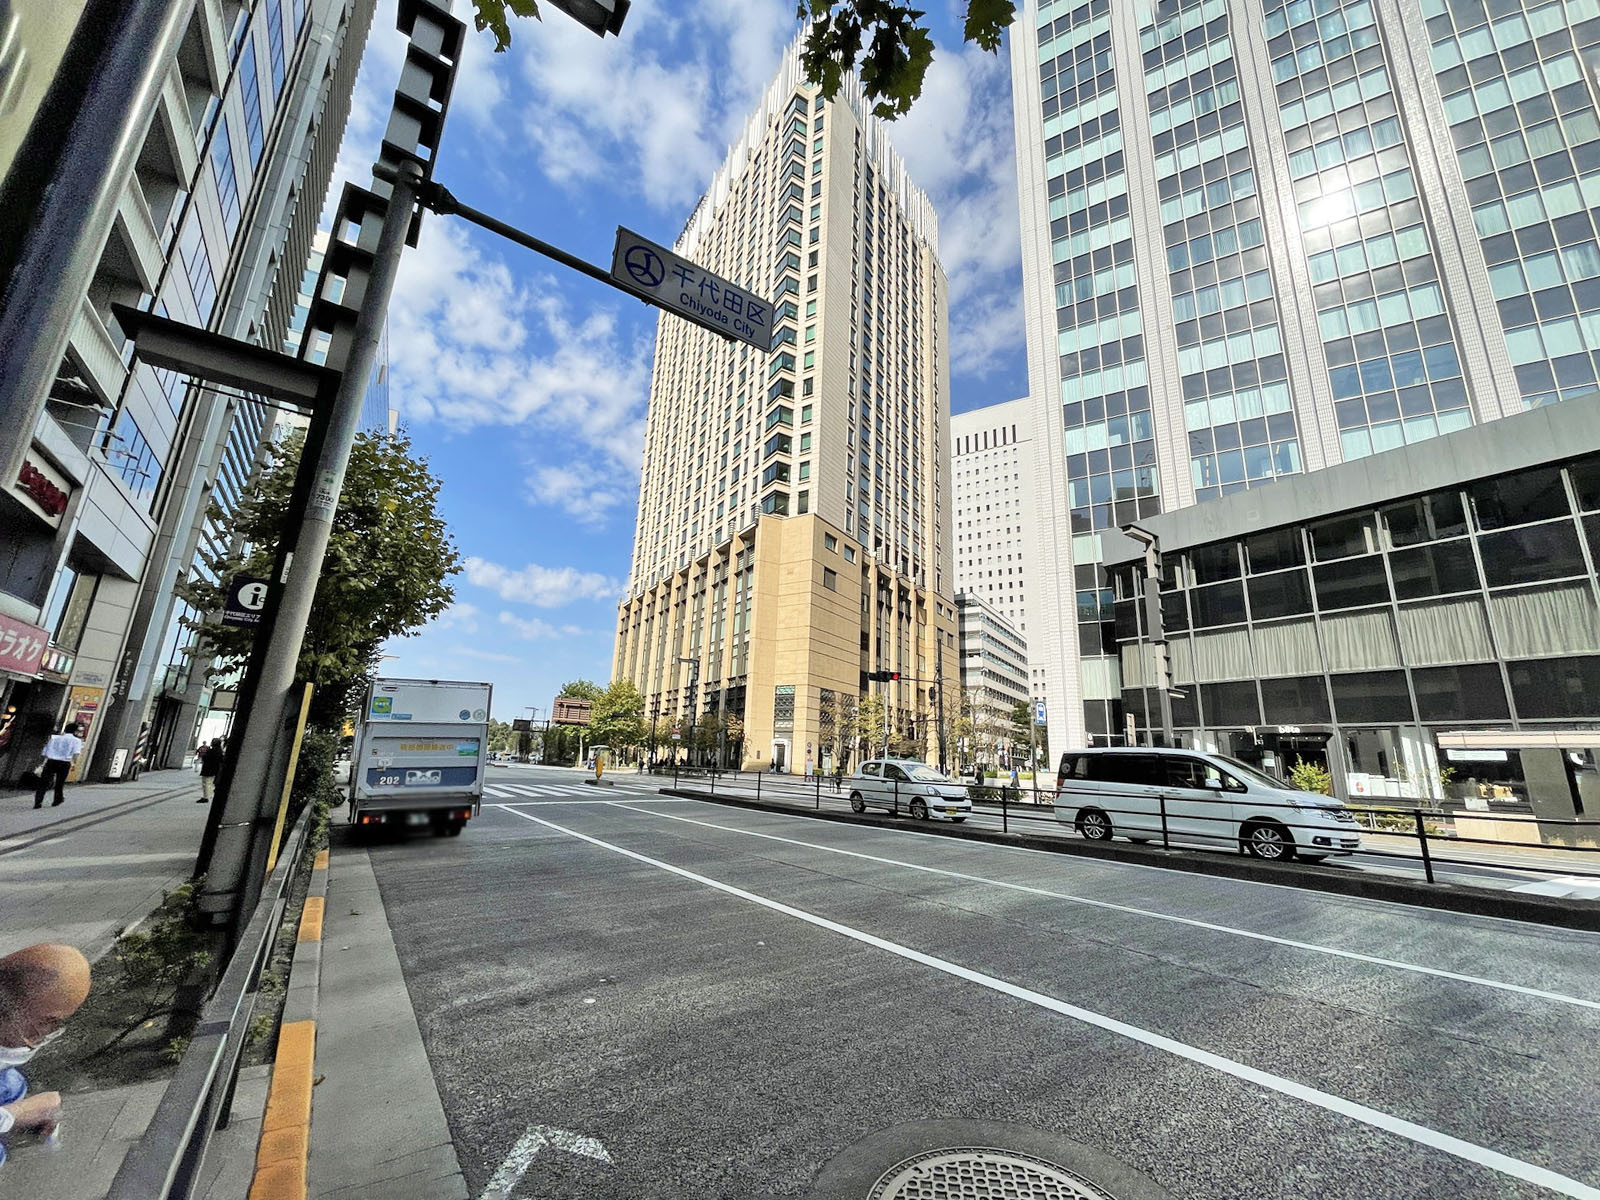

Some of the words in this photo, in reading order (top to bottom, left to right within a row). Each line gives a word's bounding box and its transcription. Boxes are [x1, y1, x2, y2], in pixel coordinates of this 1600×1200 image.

[672, 263, 767, 327] 千代田区
[680, 292, 728, 324] Chiyoda
[733, 318, 756, 338] City
[379, 776, 400, 785] 202
